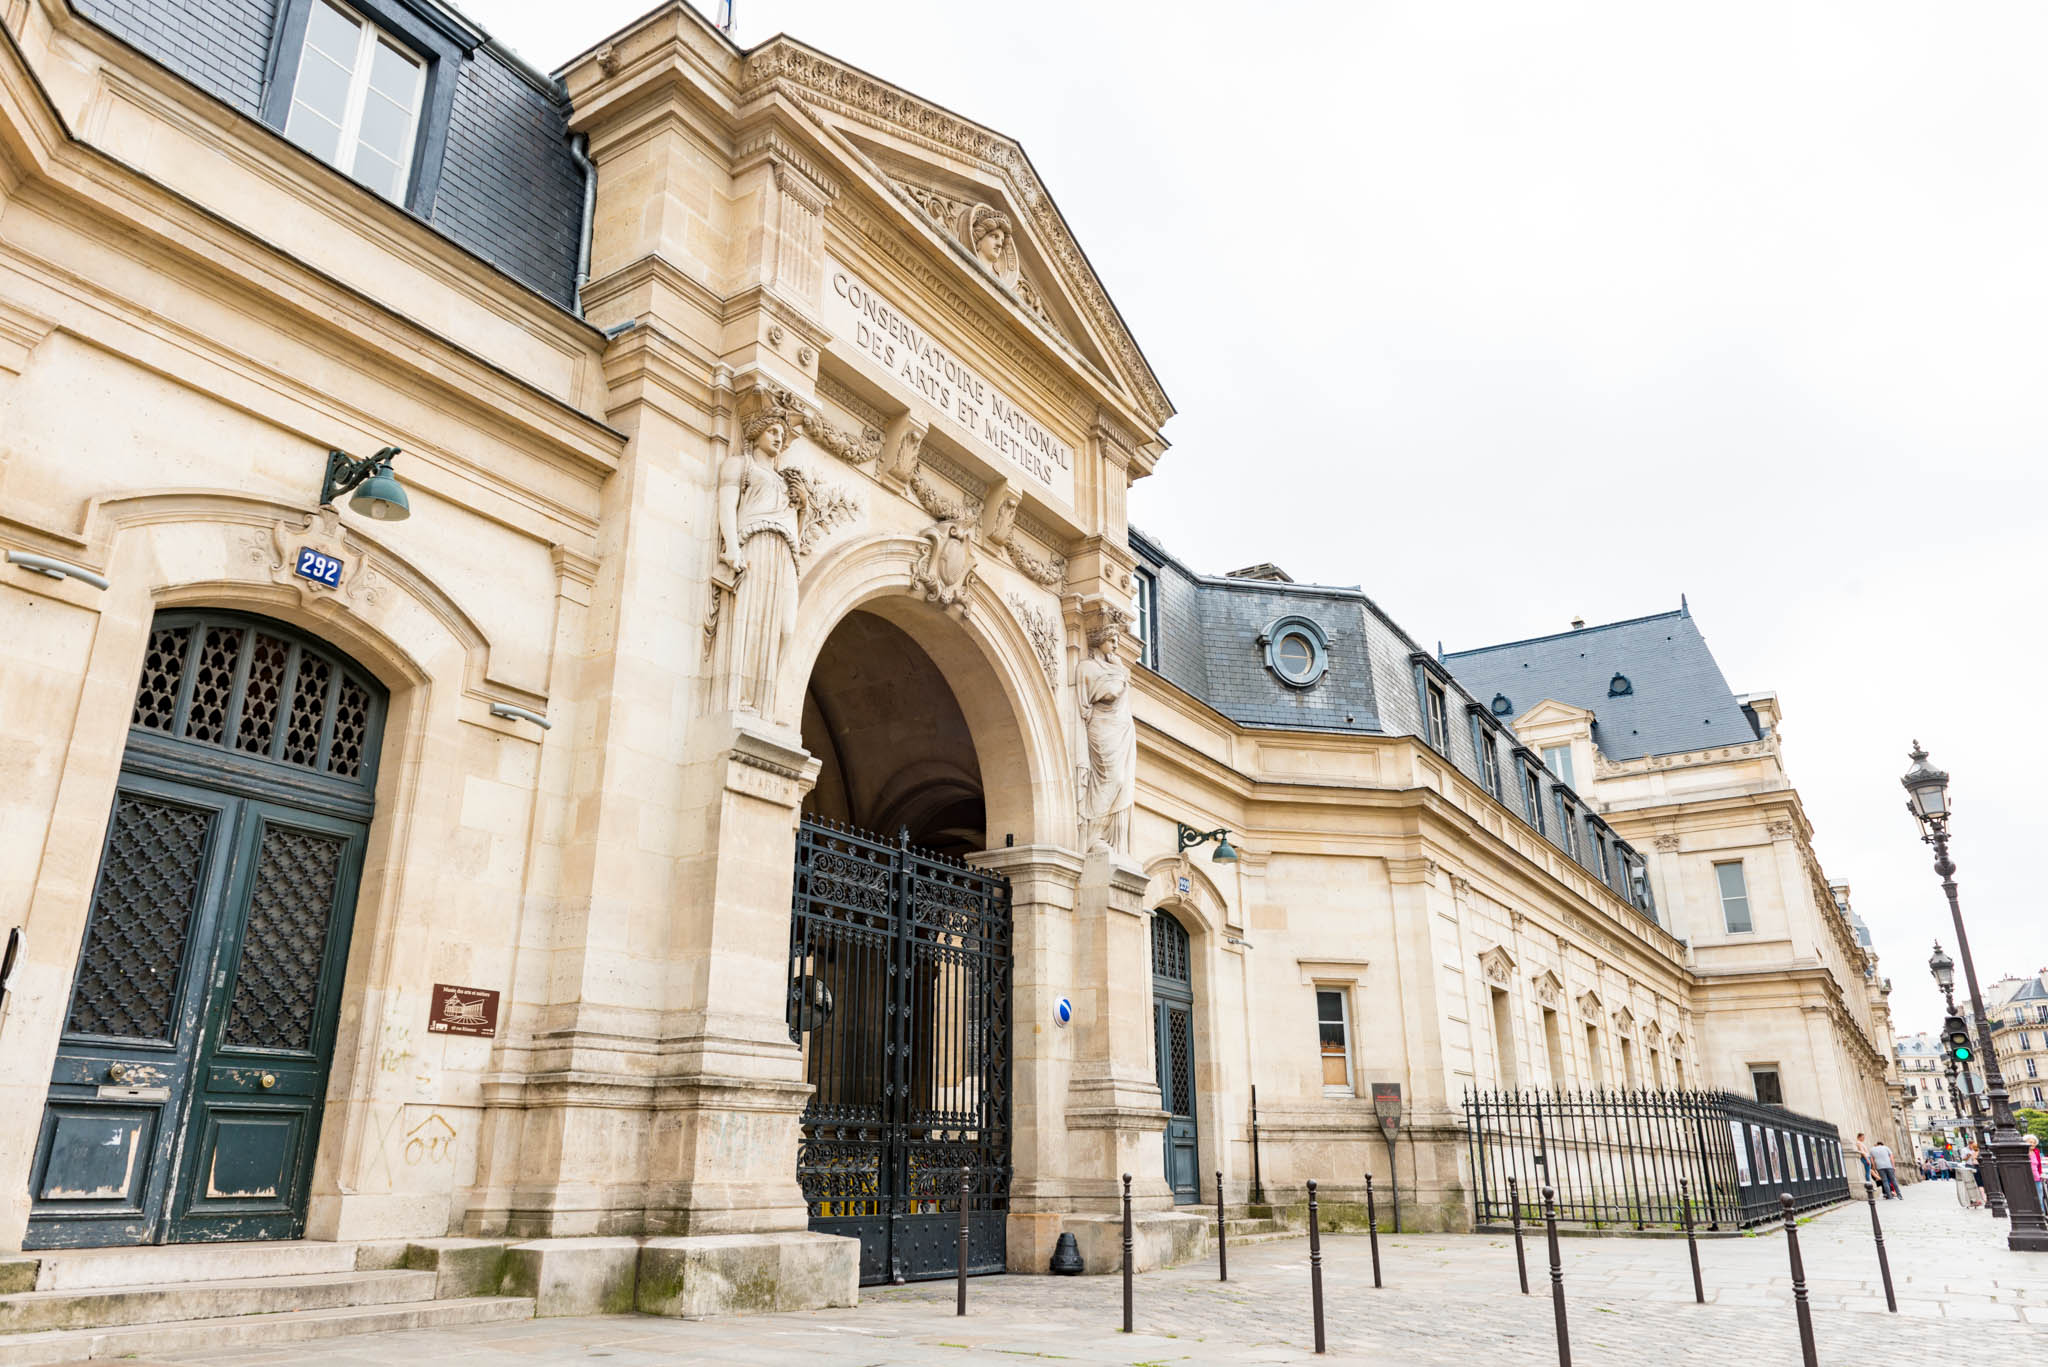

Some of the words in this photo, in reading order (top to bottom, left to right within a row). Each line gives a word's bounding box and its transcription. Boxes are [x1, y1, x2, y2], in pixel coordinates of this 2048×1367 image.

[834, 273, 984, 405] CONSERVATOIRE
[992, 394, 1068, 470] NATIONAL
[857, 321, 895, 368] DES
[901, 360, 950, 409] ARTS
[958, 398, 978, 429] ET
[985, 418, 1052, 485] METIERS
[301, 552, 338, 583] 292
